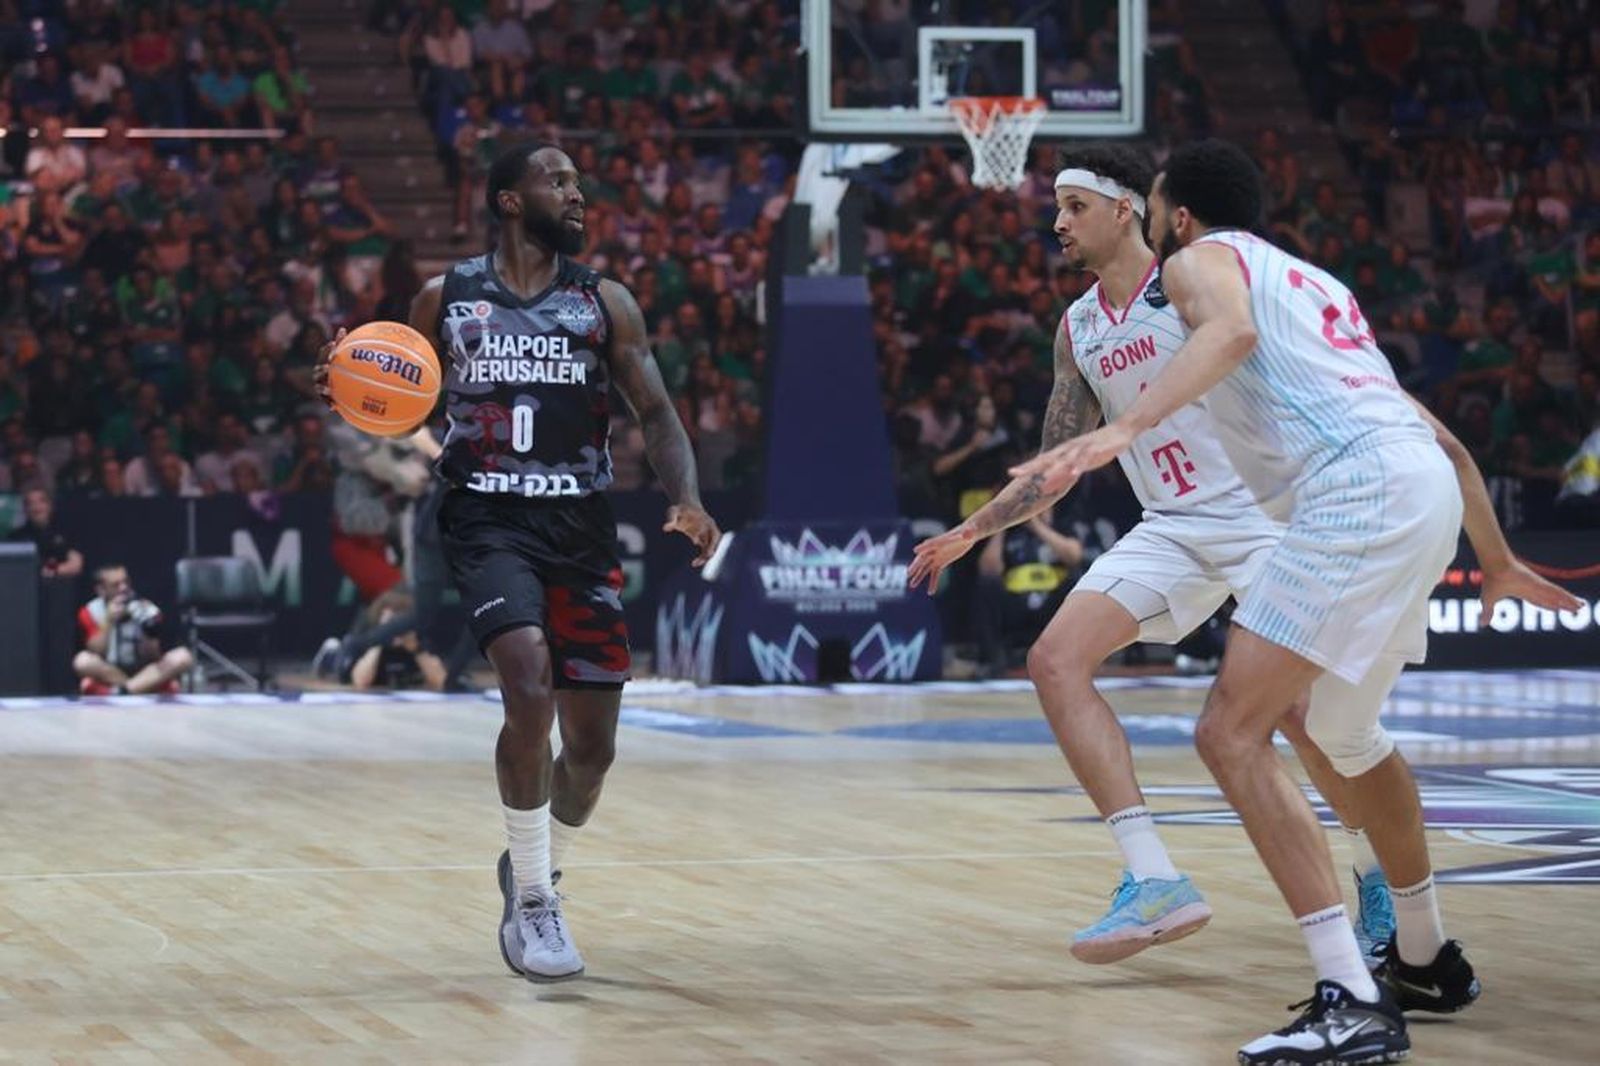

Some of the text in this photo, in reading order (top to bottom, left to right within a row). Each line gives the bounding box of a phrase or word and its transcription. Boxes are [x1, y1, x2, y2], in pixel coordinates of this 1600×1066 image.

[484, 334, 574, 360] HAPOEL
[1100, 335, 1157, 379] BONN
[350, 348, 422, 386] Wilson
[470, 358, 586, 385] JERUSALEM
[512, 404, 534, 453] 0
[466, 471, 581, 498] בנק יהב
[759, 564, 909, 592] FINAL FOUR
